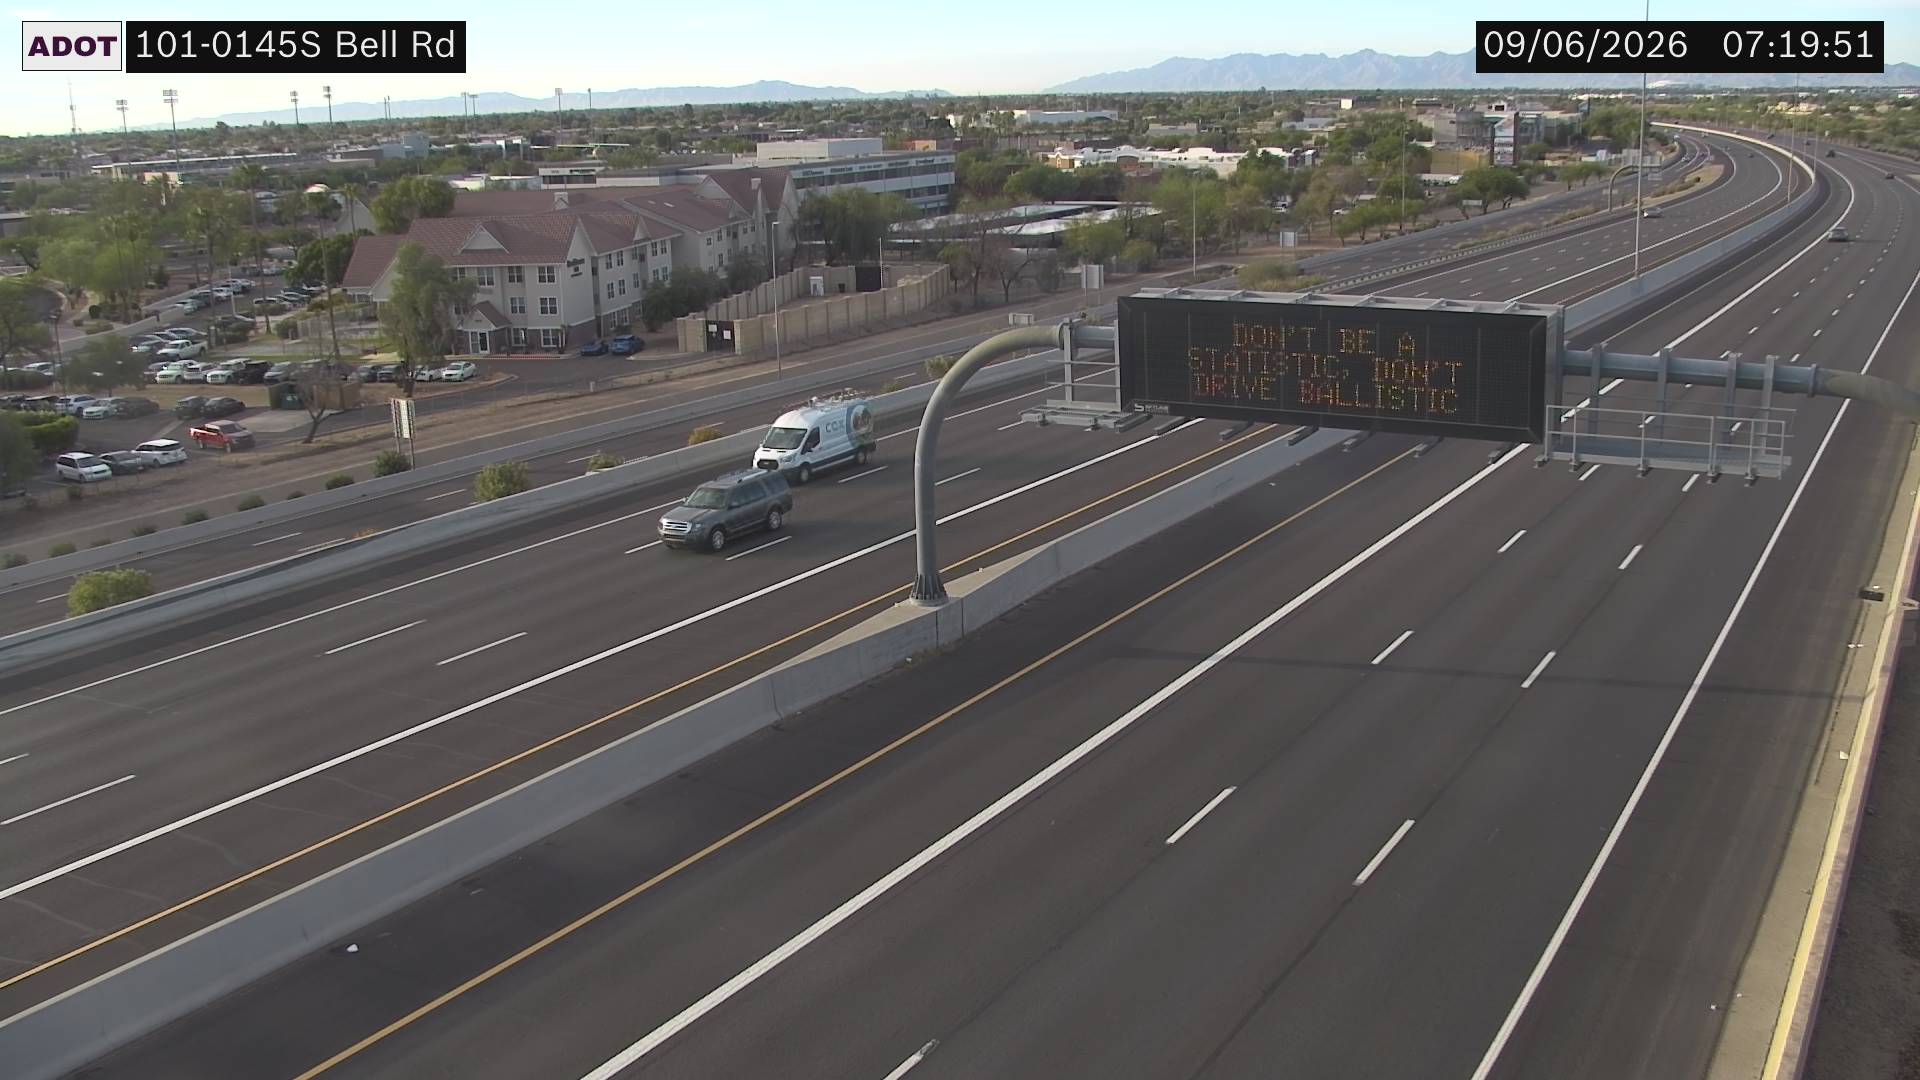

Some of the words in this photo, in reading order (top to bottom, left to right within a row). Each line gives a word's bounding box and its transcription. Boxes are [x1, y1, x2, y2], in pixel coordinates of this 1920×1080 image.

[1232, 323, 1316, 351] DON'T
[1340, 328, 1376, 354] BE
[1398, 331, 1415, 356] A
[1372, 357, 1462, 386] DON'T
[1193, 373, 1277, 400] DRIVE
[1299, 379, 1458, 414] BALLISTIC
